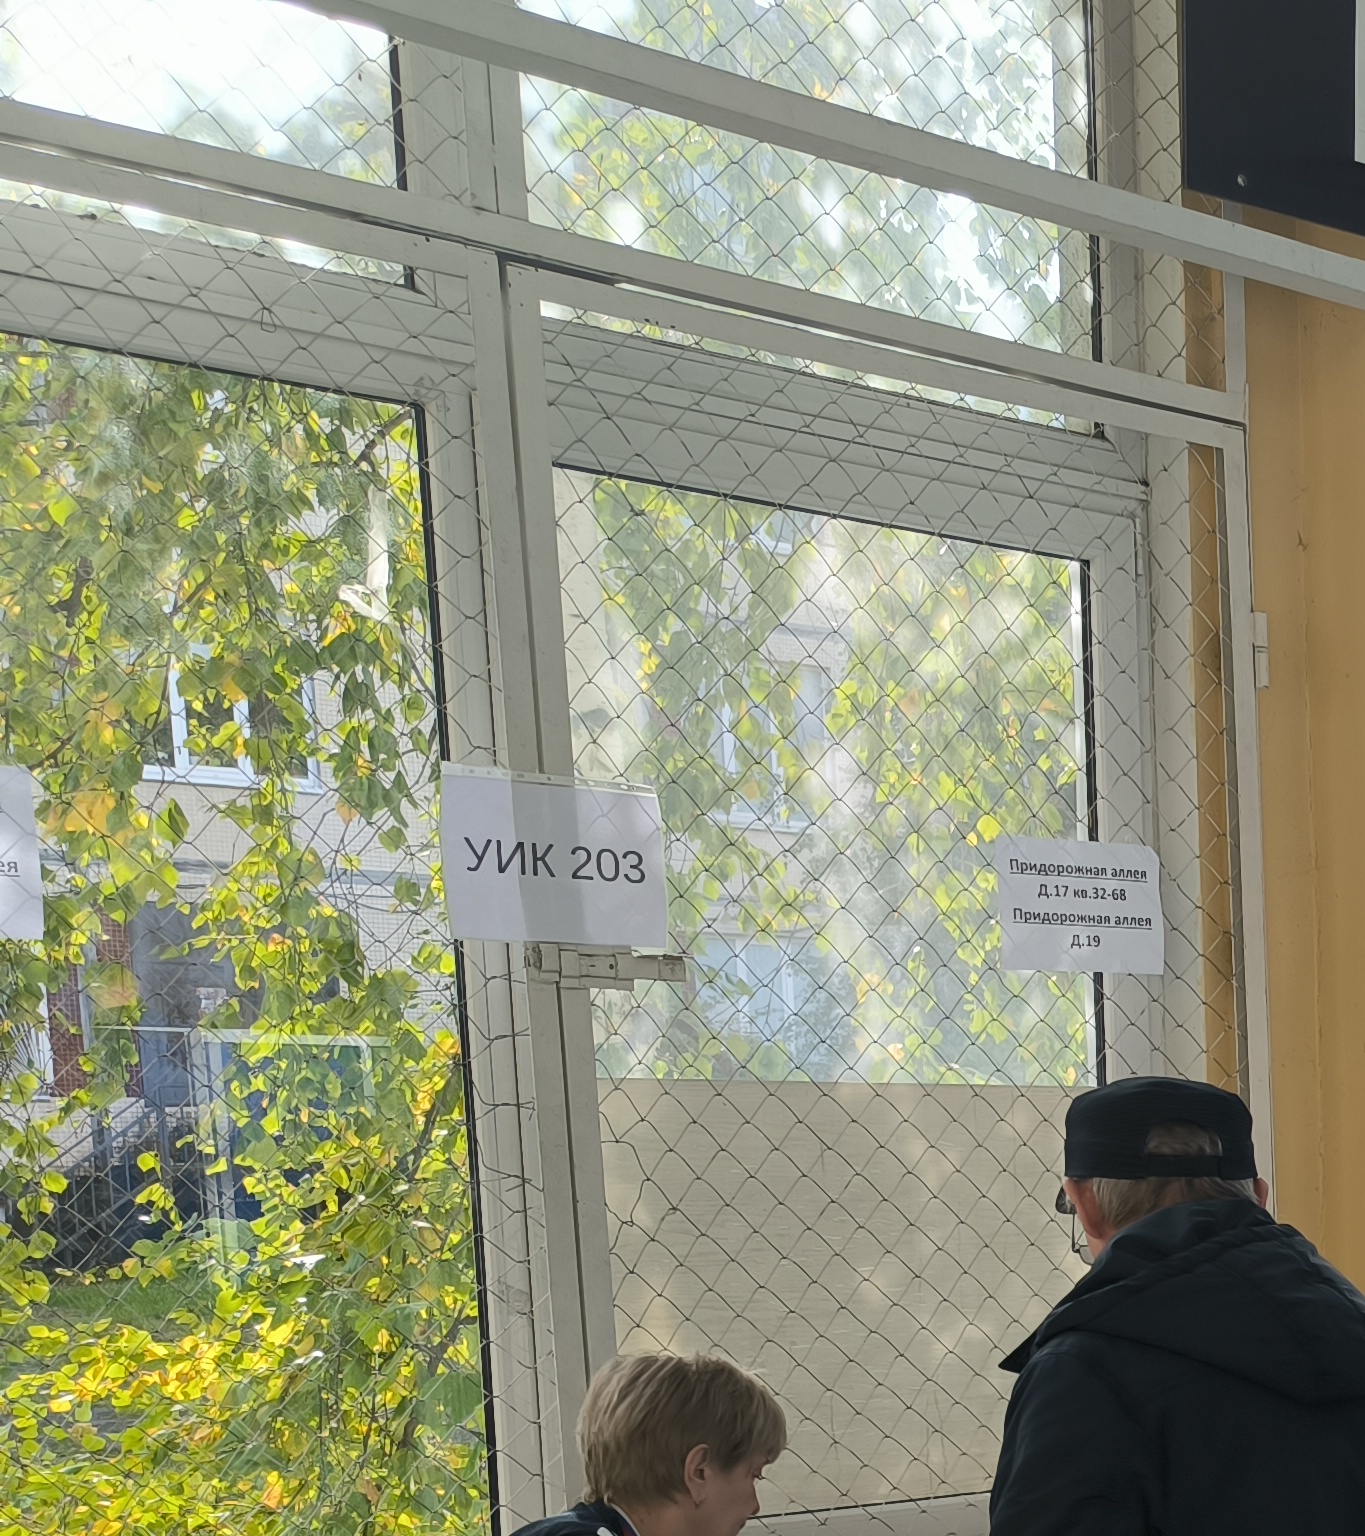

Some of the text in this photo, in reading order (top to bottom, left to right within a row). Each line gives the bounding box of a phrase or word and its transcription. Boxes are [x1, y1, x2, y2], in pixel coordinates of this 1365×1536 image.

[463, 836, 647, 884] УИК 203
[1009, 858, 1148, 881] Придорожная аллея
[1037, 883, 1127, 902] Д.17 кв.32-68
[1012, 907, 1153, 928] Придорожная аллея
[1070, 934, 1101, 950] Д.19
